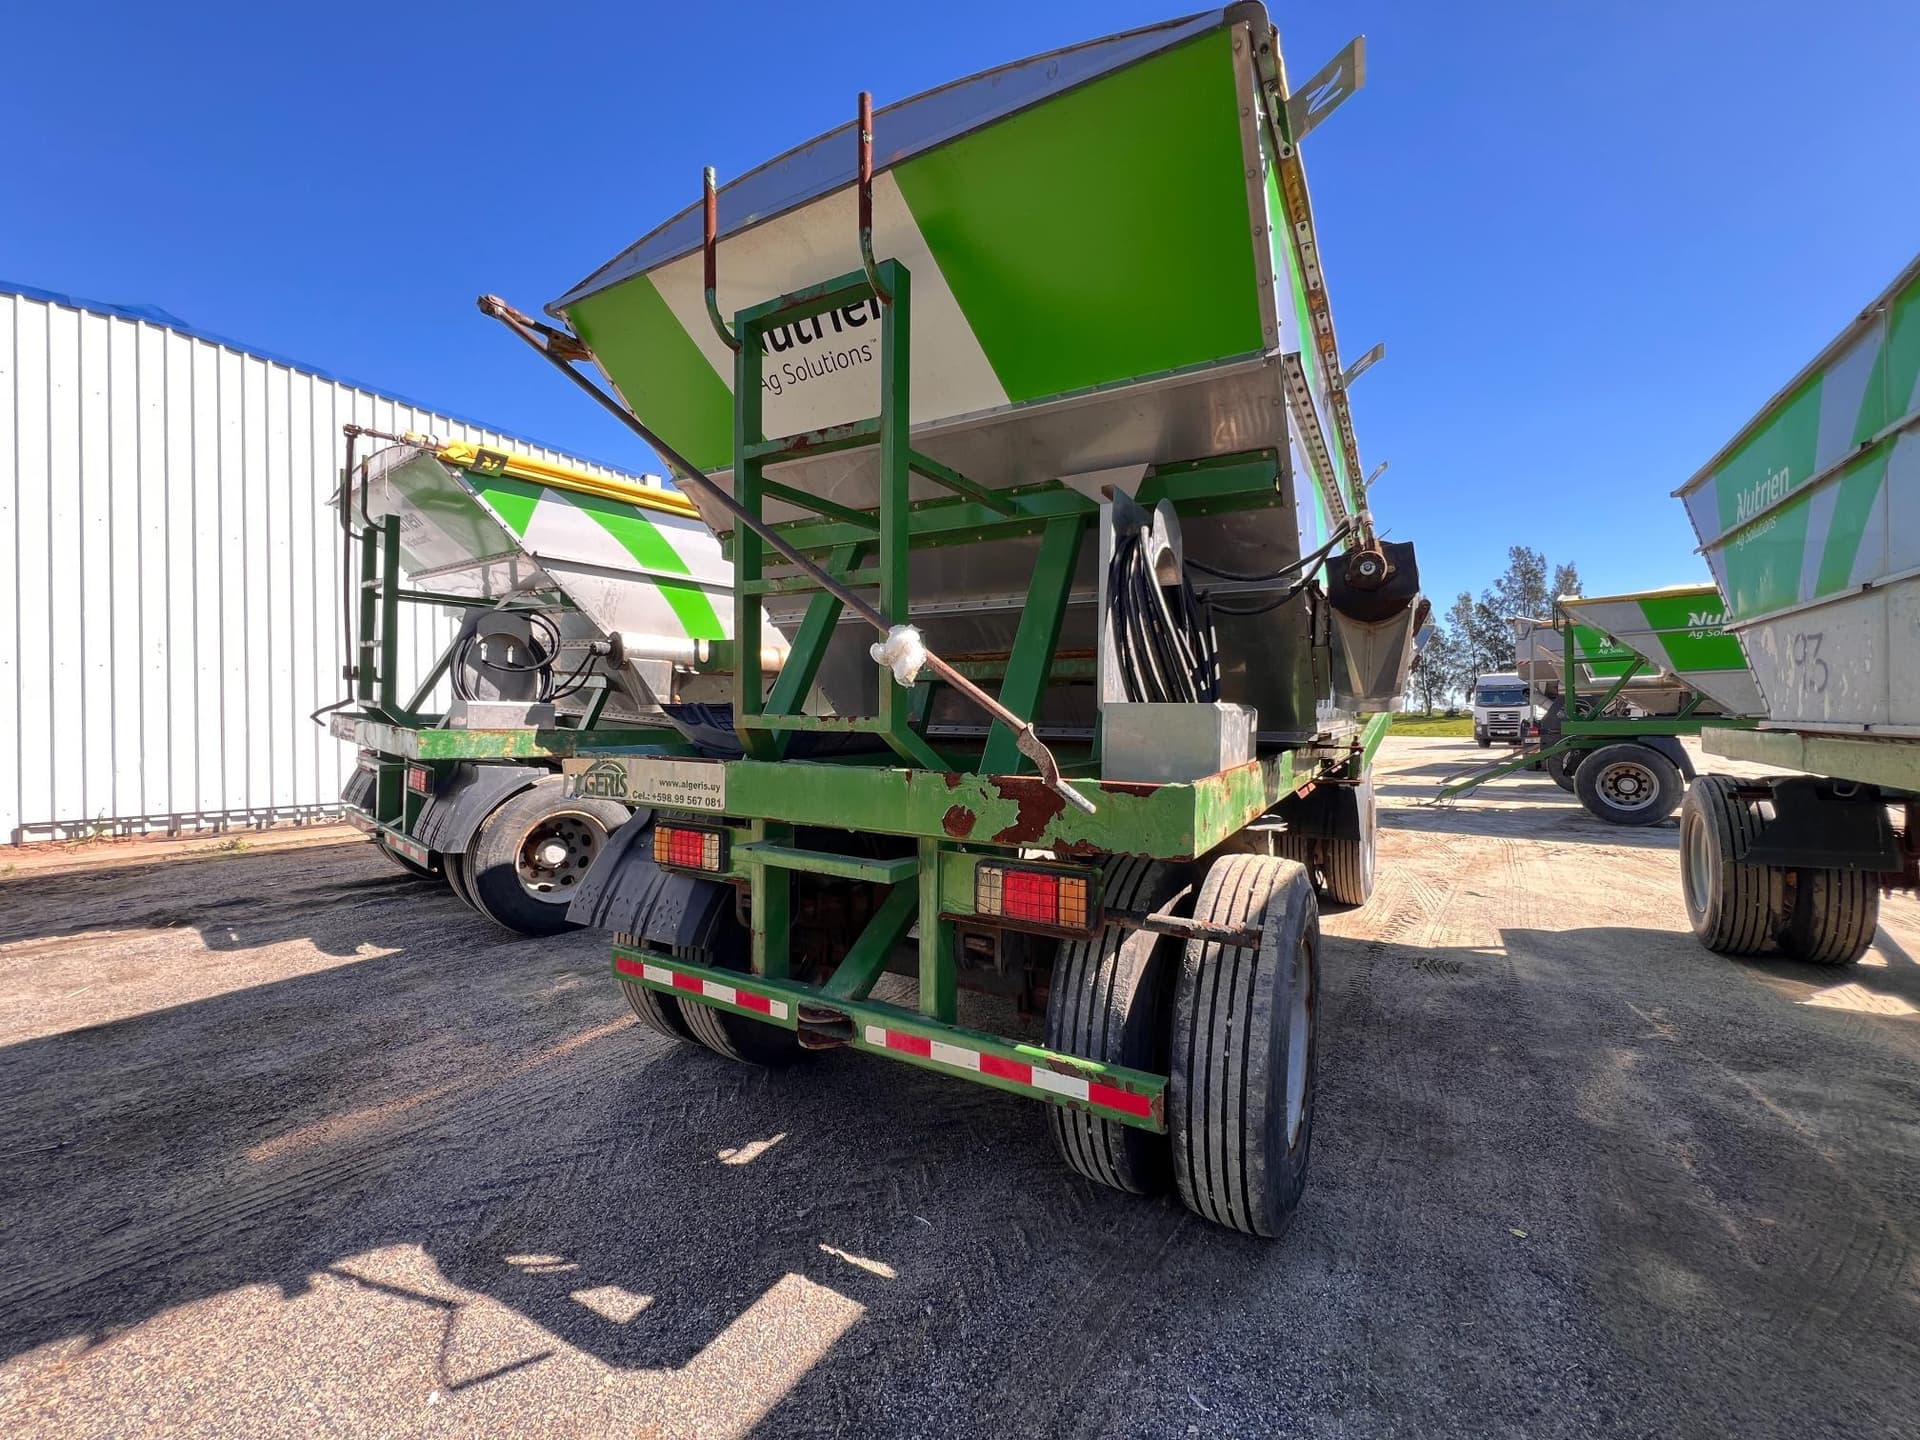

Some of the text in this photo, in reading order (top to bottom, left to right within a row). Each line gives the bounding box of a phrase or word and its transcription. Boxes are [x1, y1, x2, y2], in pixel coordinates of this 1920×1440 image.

[783, 344, 873, 385] Solutions
[1737, 466, 1789, 524] Nutrien
[659, 779, 721, 793] www.algeris.uy
[687, 795, 702, 806] 567
[705, 797, 721, 808] 081
